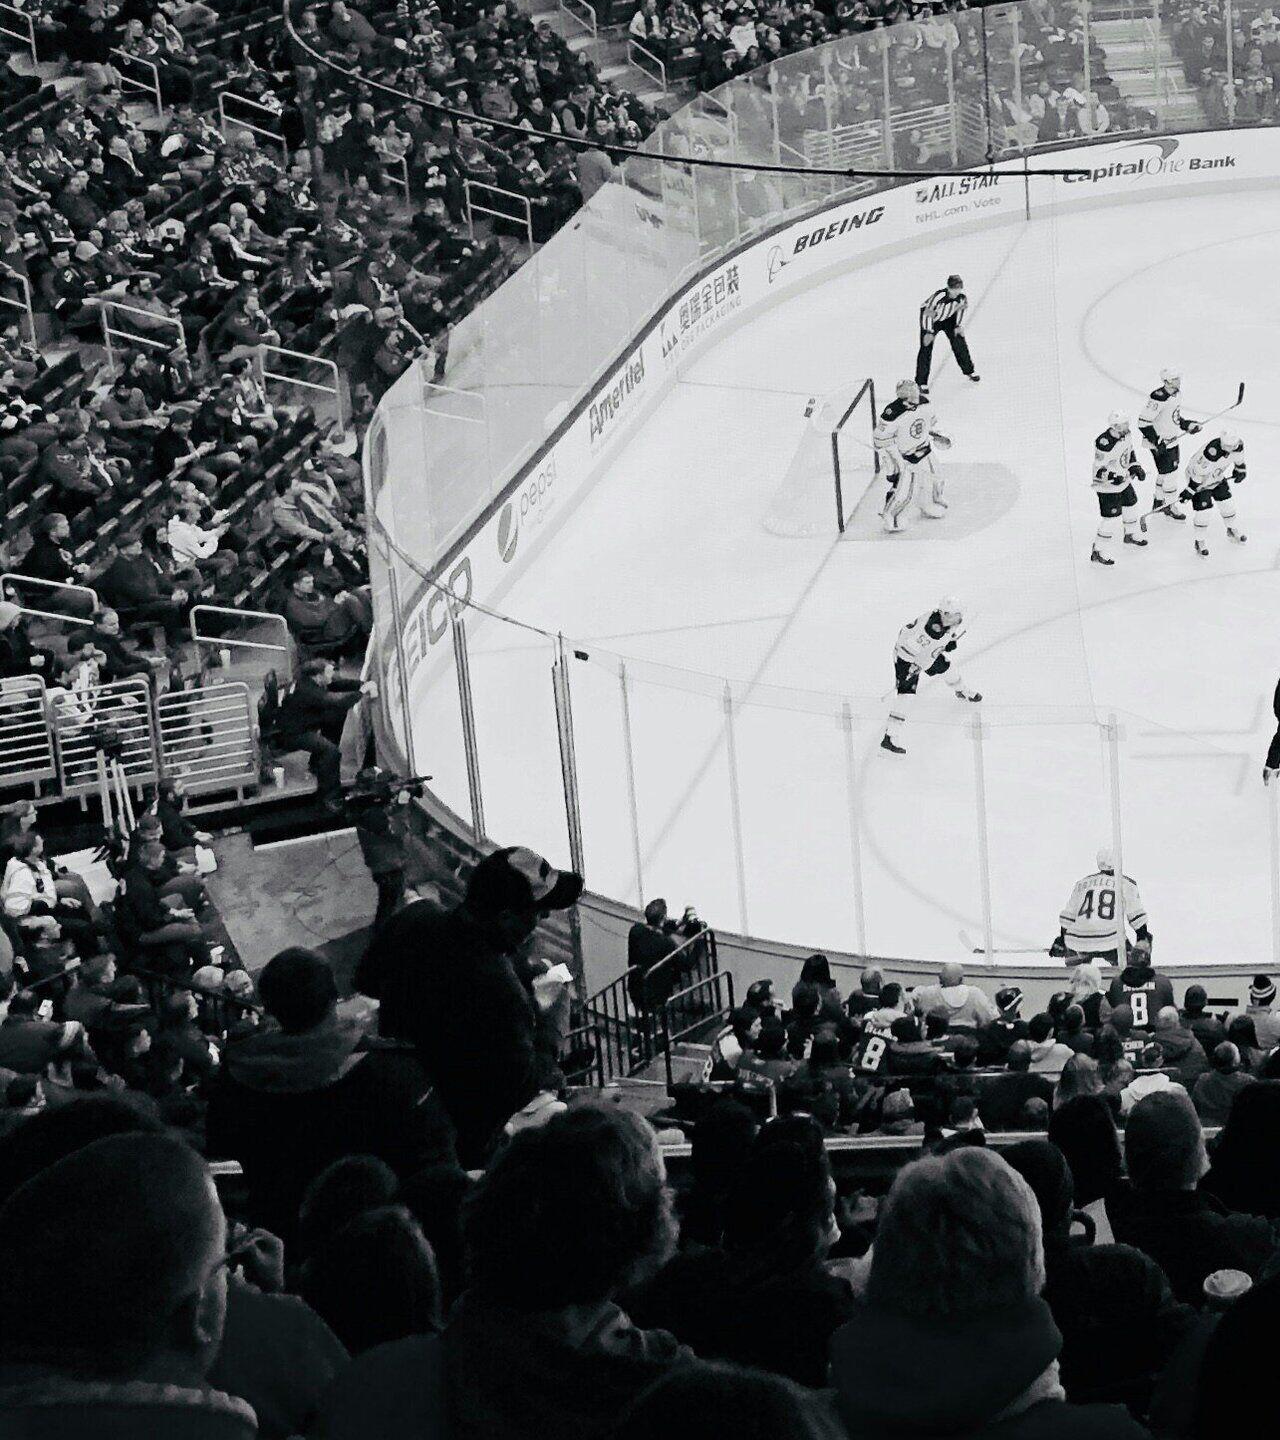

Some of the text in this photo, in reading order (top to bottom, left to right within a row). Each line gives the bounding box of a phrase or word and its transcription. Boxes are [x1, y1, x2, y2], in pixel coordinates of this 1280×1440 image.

[1188, 154, 1237, 172] Bank
[792, 204, 886, 256] BOEING
[588, 347, 646, 445] Ameritel
[516, 451, 557, 530] pepsi
[1078, 889, 1115, 920] 48
[1130, 991, 1149, 1027] 8
[861, 1035, 887, 1072] 8
